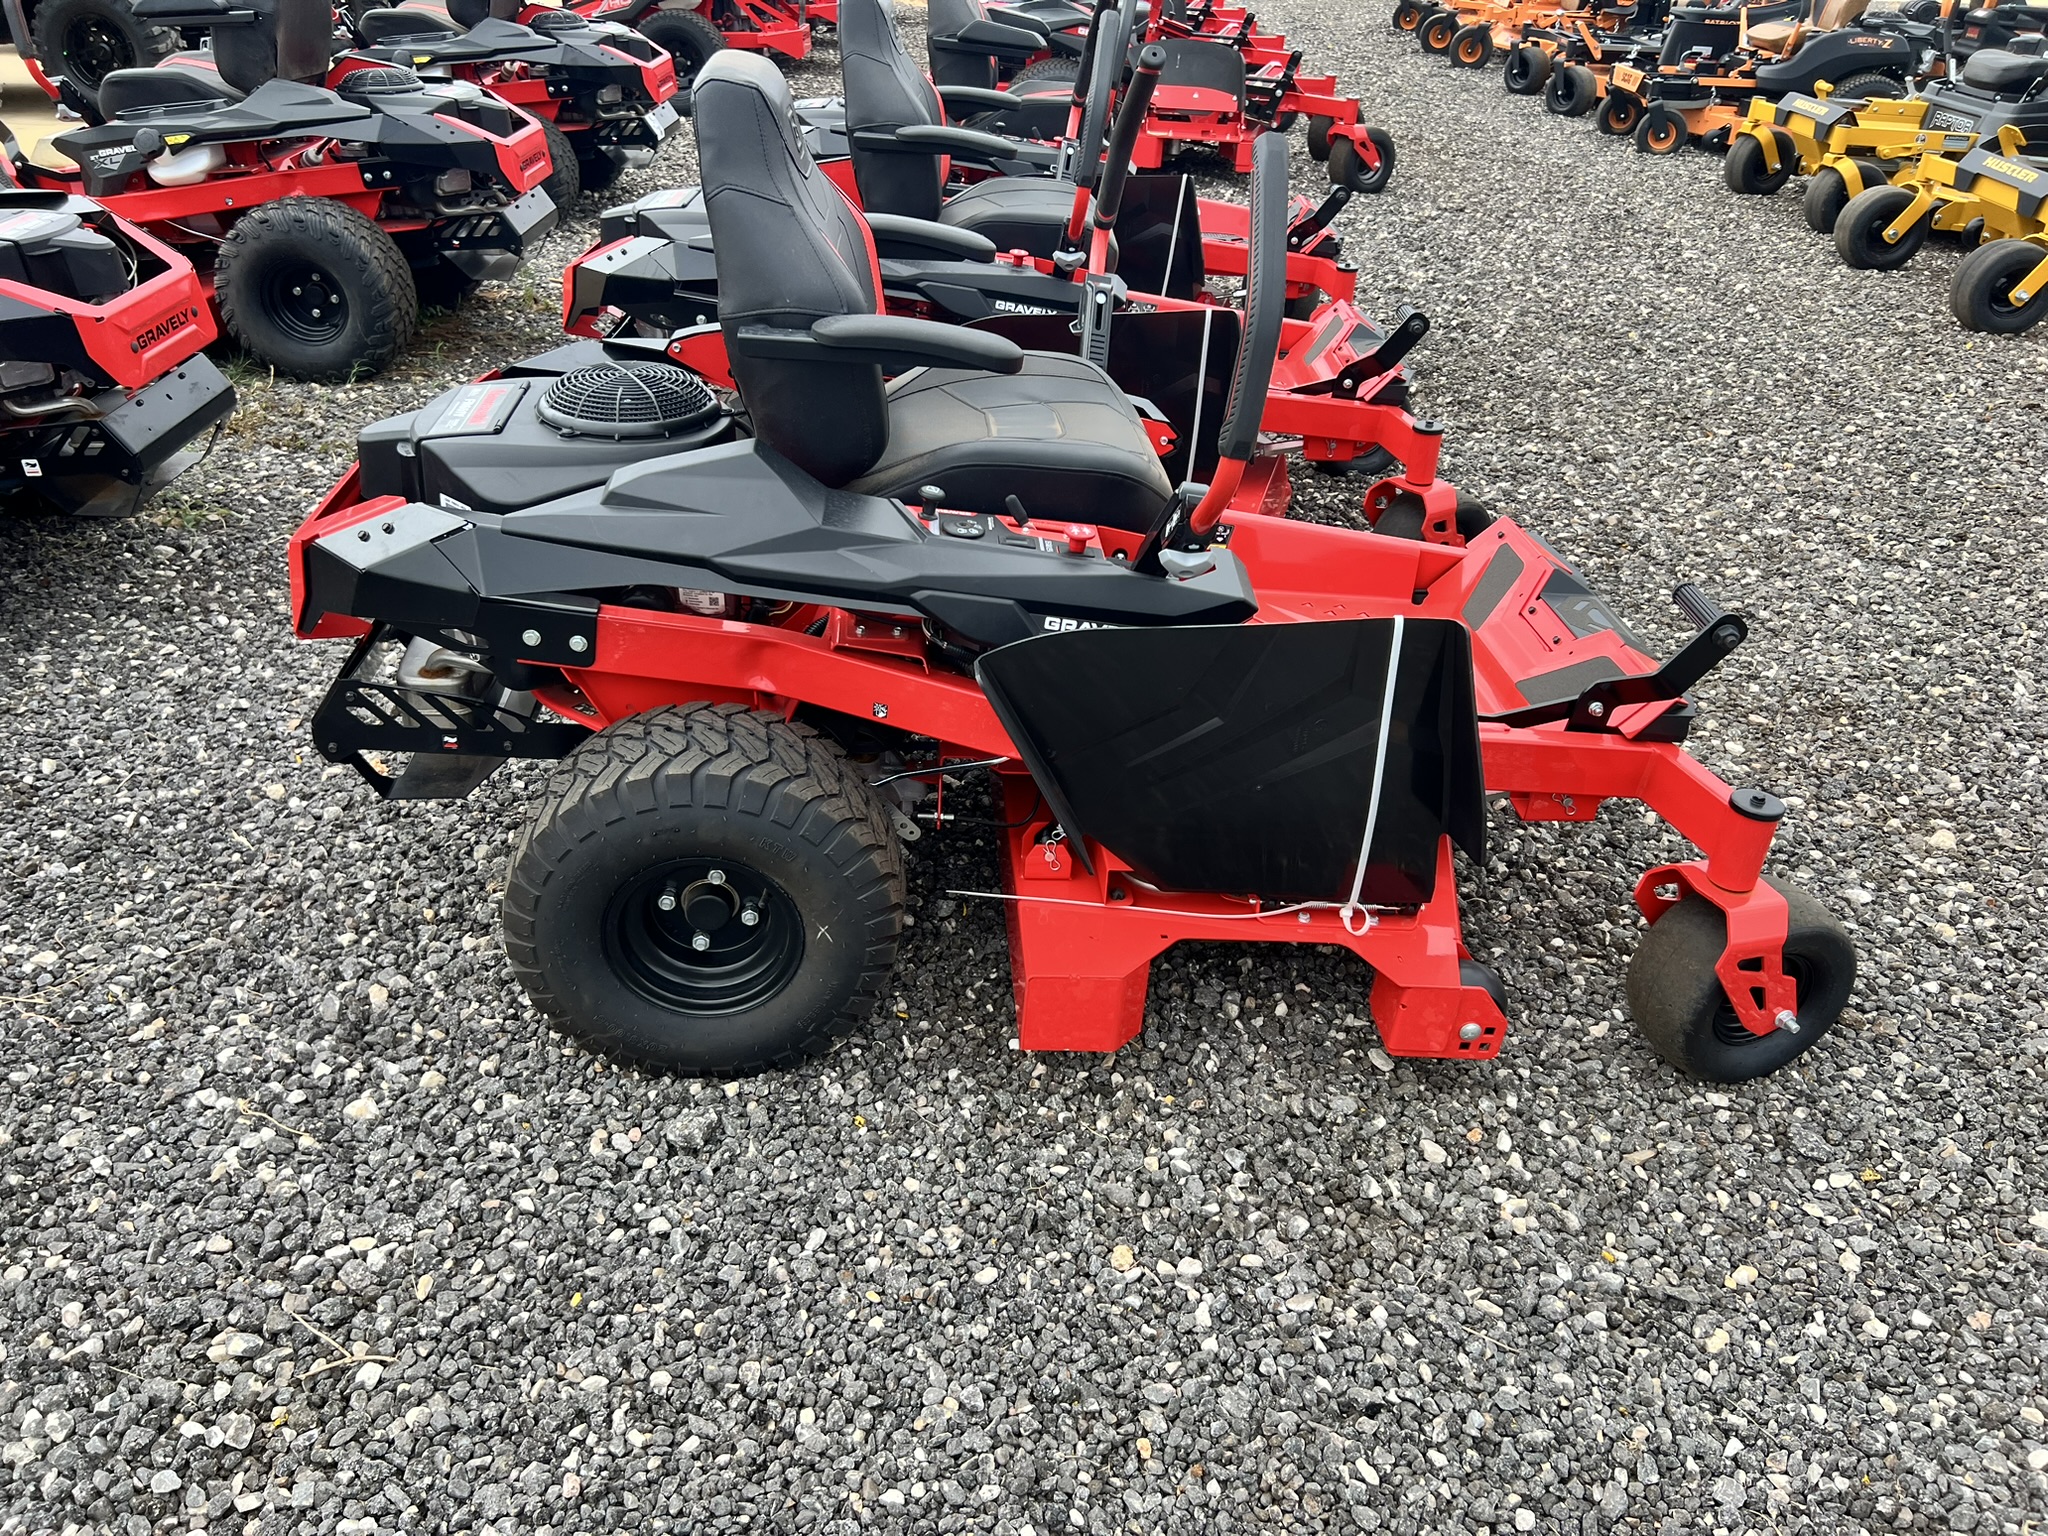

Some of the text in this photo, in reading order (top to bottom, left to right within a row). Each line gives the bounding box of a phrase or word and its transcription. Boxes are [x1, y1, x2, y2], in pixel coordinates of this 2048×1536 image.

[1792, 98, 1830, 116] HUSTLER
[1929, 110, 1974, 134] RAPTOR
[1982, 156, 2039, 184] HUSTLER
[136, 308, 190, 350] GRAVELY
